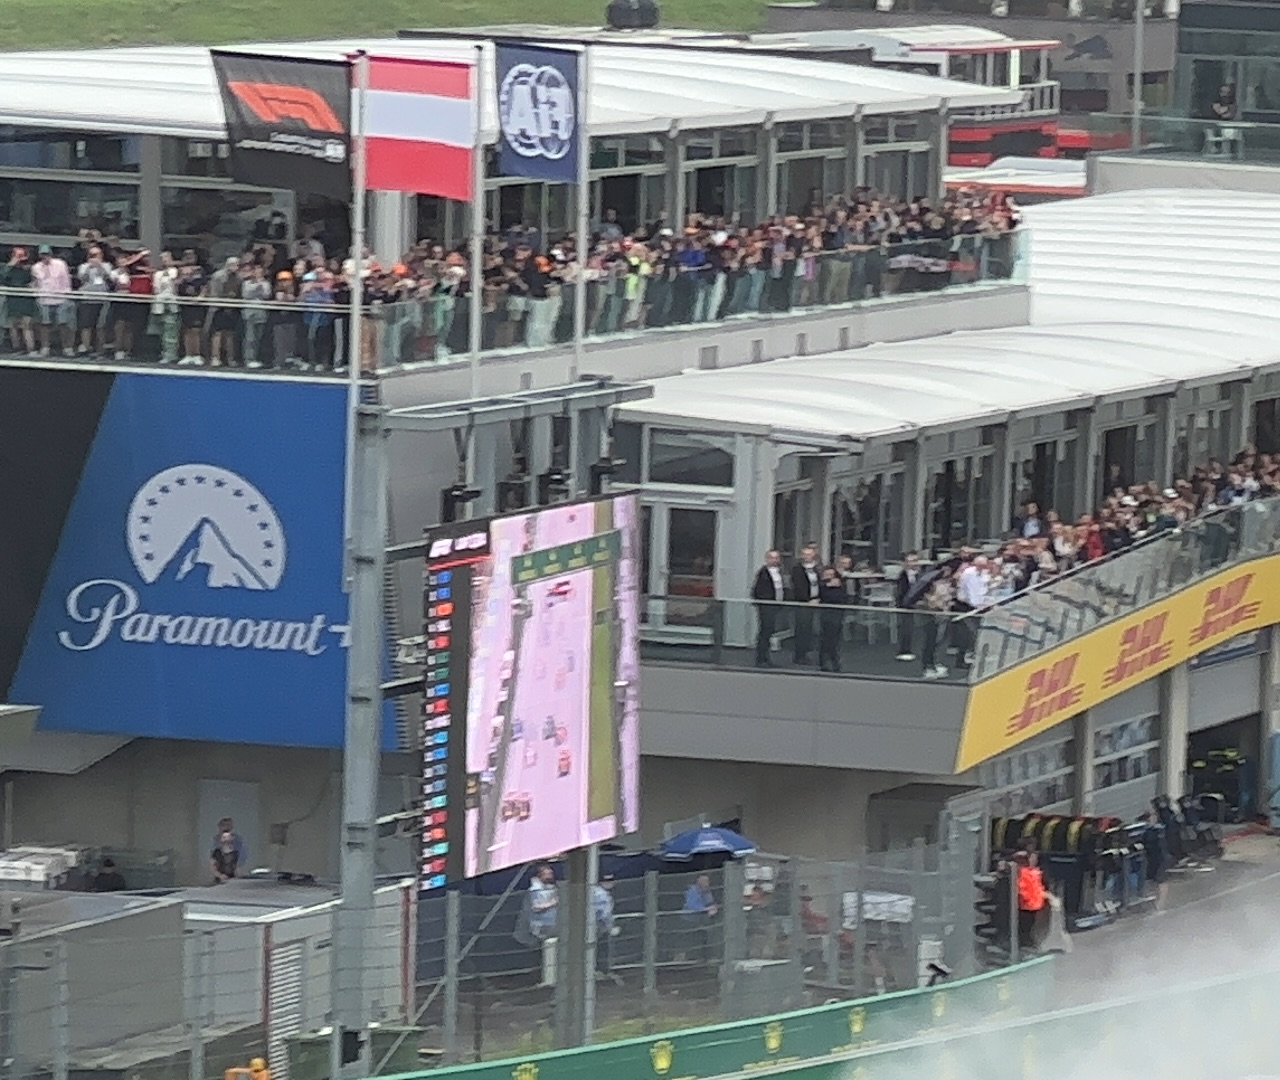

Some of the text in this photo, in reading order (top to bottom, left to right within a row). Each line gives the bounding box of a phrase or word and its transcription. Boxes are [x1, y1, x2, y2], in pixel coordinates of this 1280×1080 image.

[1006, 653, 1084, 735] DHL
[1102, 611, 1174, 689] DHL
[1189, 573, 1262, 646] DHL
